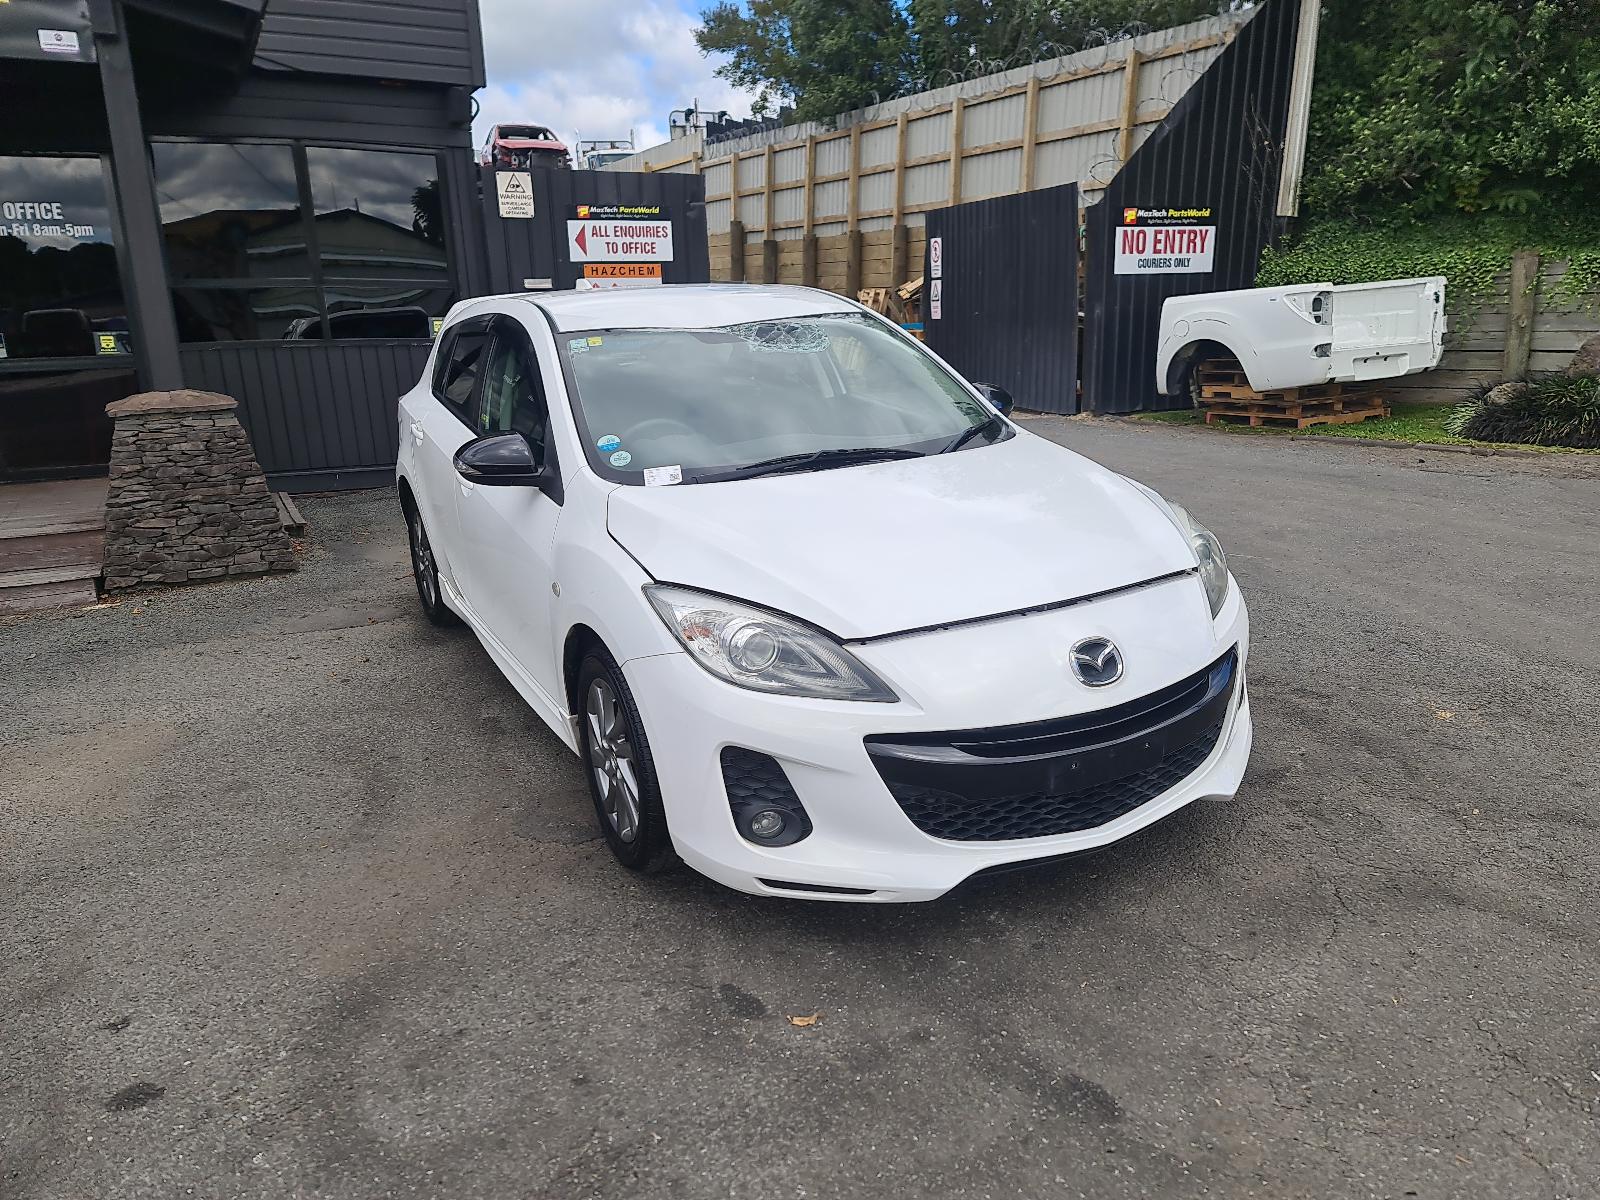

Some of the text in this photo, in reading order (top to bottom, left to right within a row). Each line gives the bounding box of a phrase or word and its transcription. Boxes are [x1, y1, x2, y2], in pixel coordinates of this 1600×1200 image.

[2, 202, 64, 220] OFFICE
[619, 206, 660, 214] PartsWorld
[1137, 209, 1167, 217] MaxTech
[1168, 208, 1210, 217] PartsWorld
[32, 223, 94, 238] 8am-5pm
[591, 225, 668, 239] ALL ENQUIRIES
[1122, 229, 1209, 254] NO ENTRY
[605, 242, 657, 254] TO OFFICE
[1137, 257, 1191, 268] COURIERS ONLY
[591, 266, 655, 276] HAZCHEM
